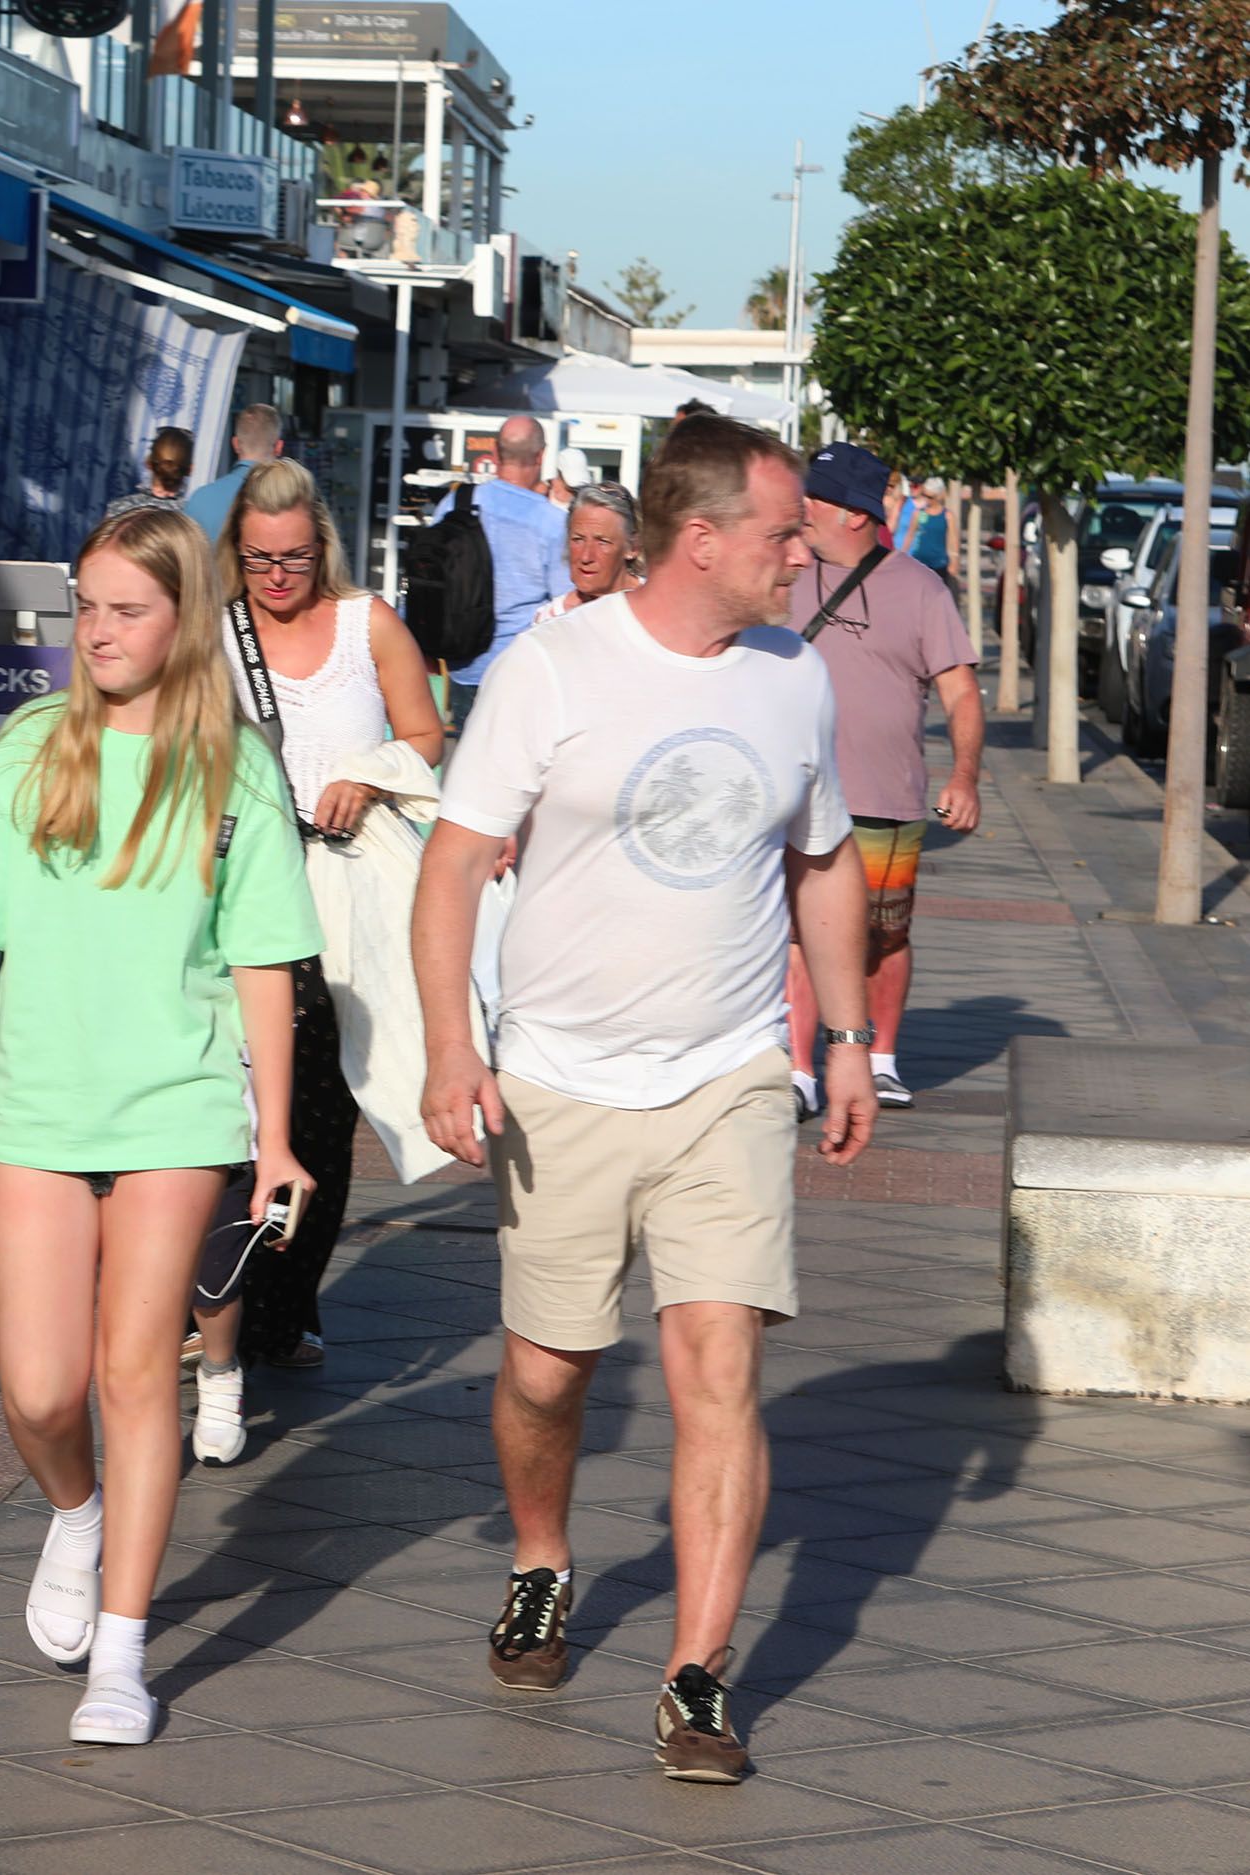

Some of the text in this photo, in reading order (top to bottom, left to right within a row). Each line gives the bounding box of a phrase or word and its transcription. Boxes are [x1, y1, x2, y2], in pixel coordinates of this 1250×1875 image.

[182, 162, 253, 192] Tabacos
[182, 193, 256, 222] Licores
[241, 634, 259, 664] KORS
[251, 668, 274, 718] MICHAEL
